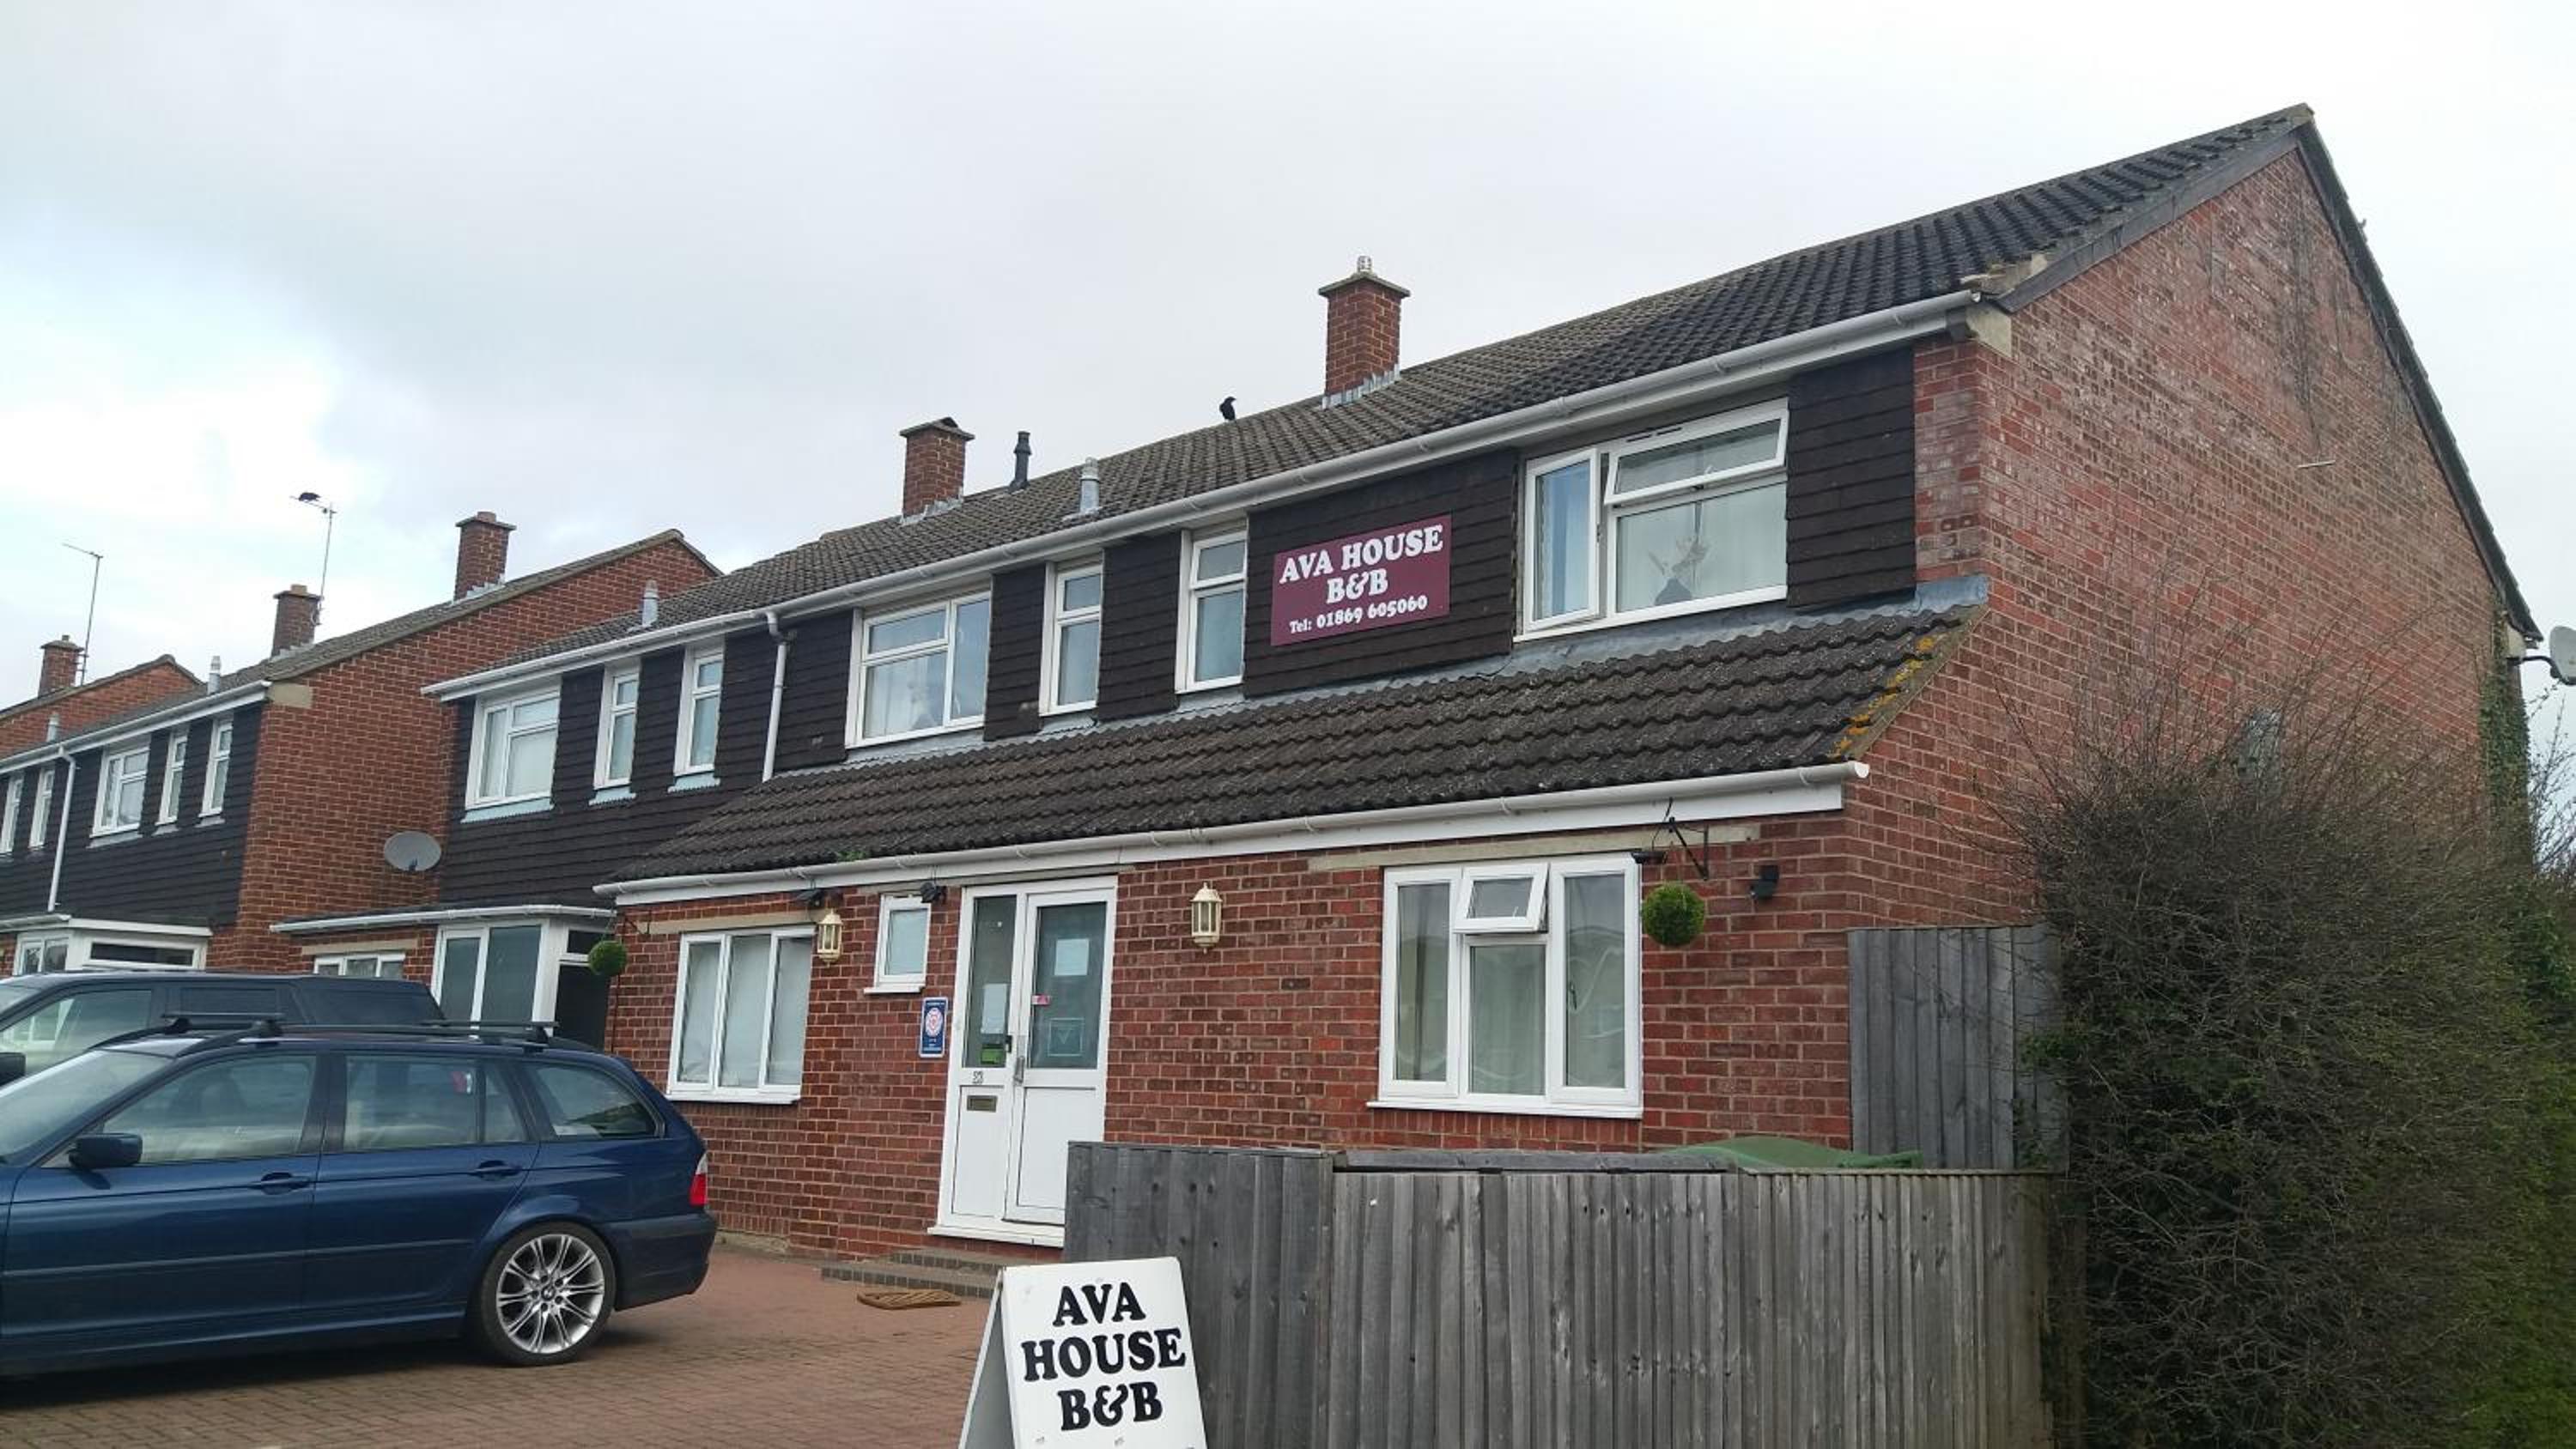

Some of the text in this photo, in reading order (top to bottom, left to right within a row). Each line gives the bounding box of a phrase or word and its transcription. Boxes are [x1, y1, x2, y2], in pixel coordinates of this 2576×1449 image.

[1279, 524, 1443, 583] AVA HOUSE
[1327, 568, 1388, 603] B&B
[1290, 595, 1427, 634] Tel: 01869 605060
[1053, 1282, 1145, 1326] AVA
[1022, 1328, 1186, 1381] HOUSE
[1058, 1382, 1163, 1431] B&B
